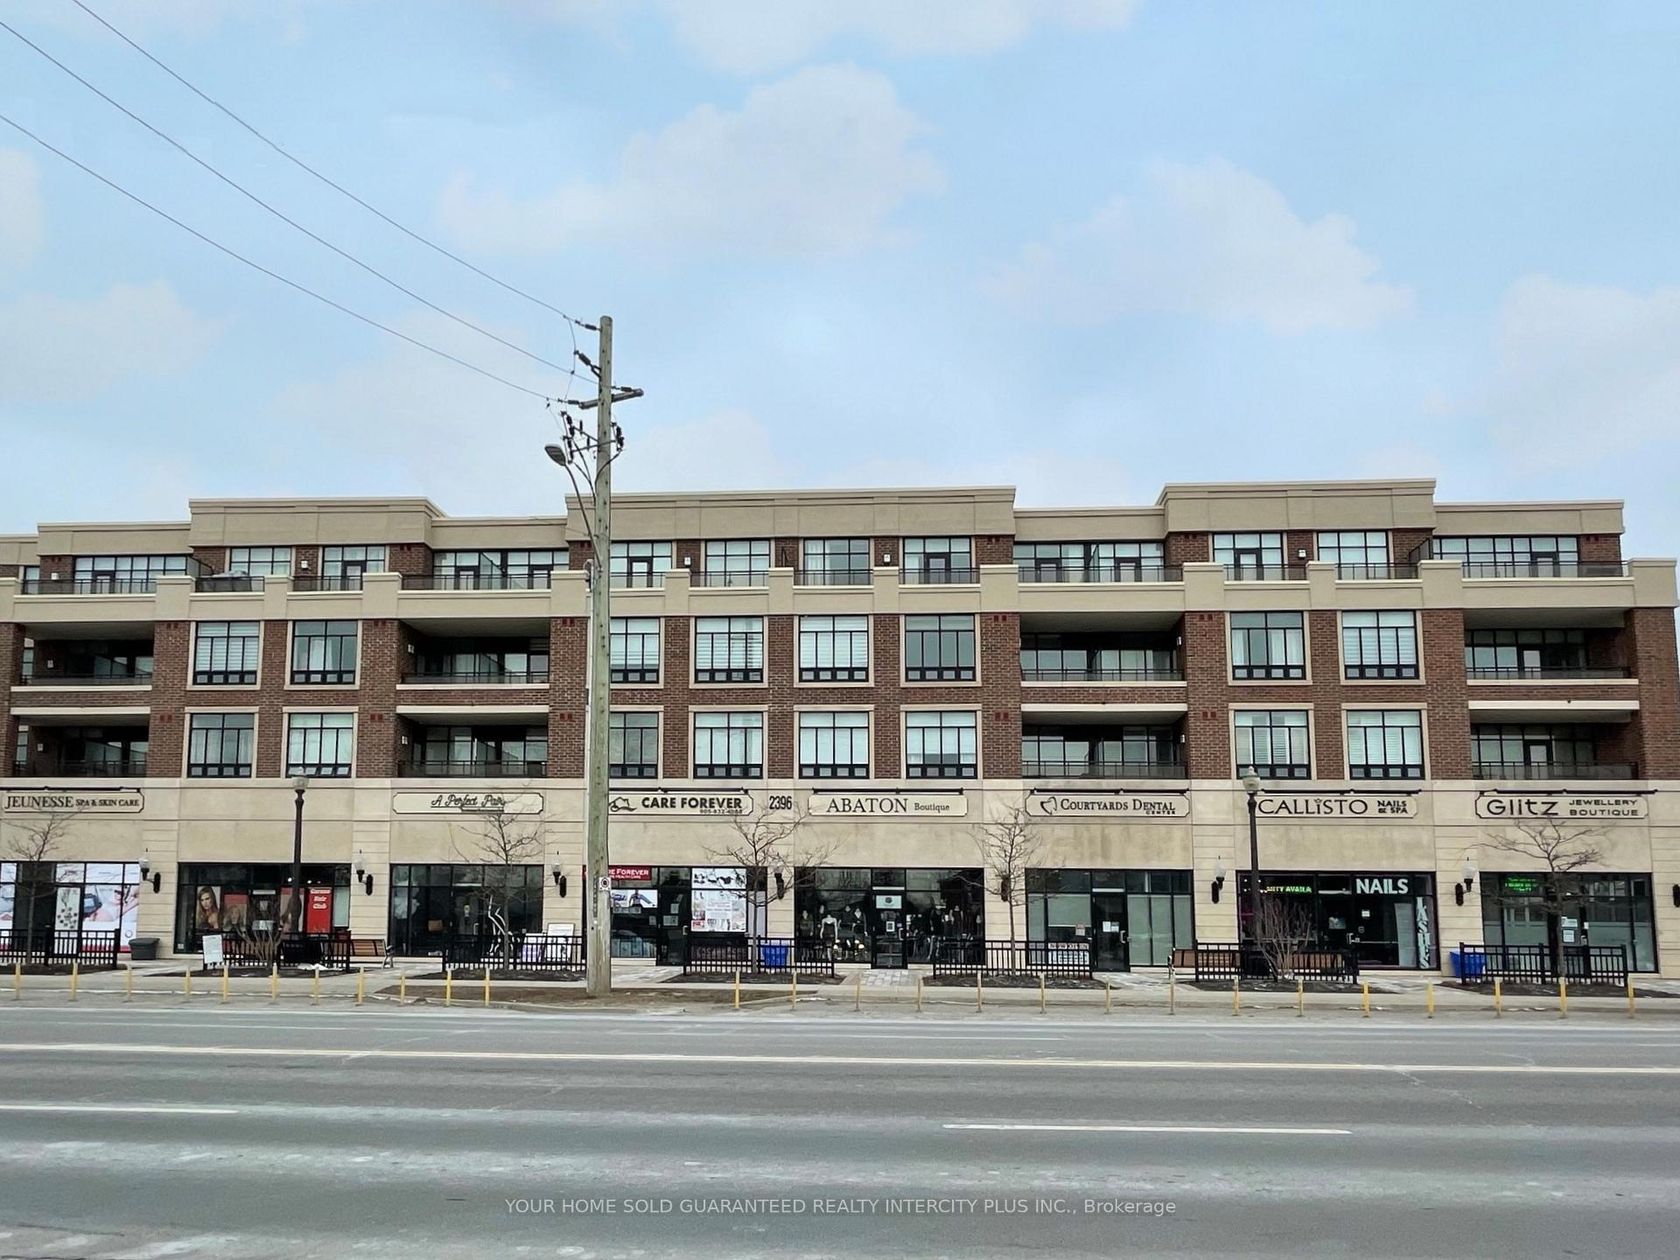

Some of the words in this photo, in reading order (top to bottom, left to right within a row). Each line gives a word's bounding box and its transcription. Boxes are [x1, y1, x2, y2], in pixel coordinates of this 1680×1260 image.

[4, 795, 74, 809] JEUNESSE
[75, 799, 89, 807] SPA
[90, 799, 97, 807] &
[99, 799, 117, 807] SKIN
[119, 799, 140, 807] CARE
[641, 797, 676, 809] CARE
[681, 797, 742, 809] FOREVER
[769, 796, 792, 810] 2396
[826, 798, 908, 813] ABATON
[914, 802, 950, 813] Boutique
[1356, 878, 1409, 894] NAILS
